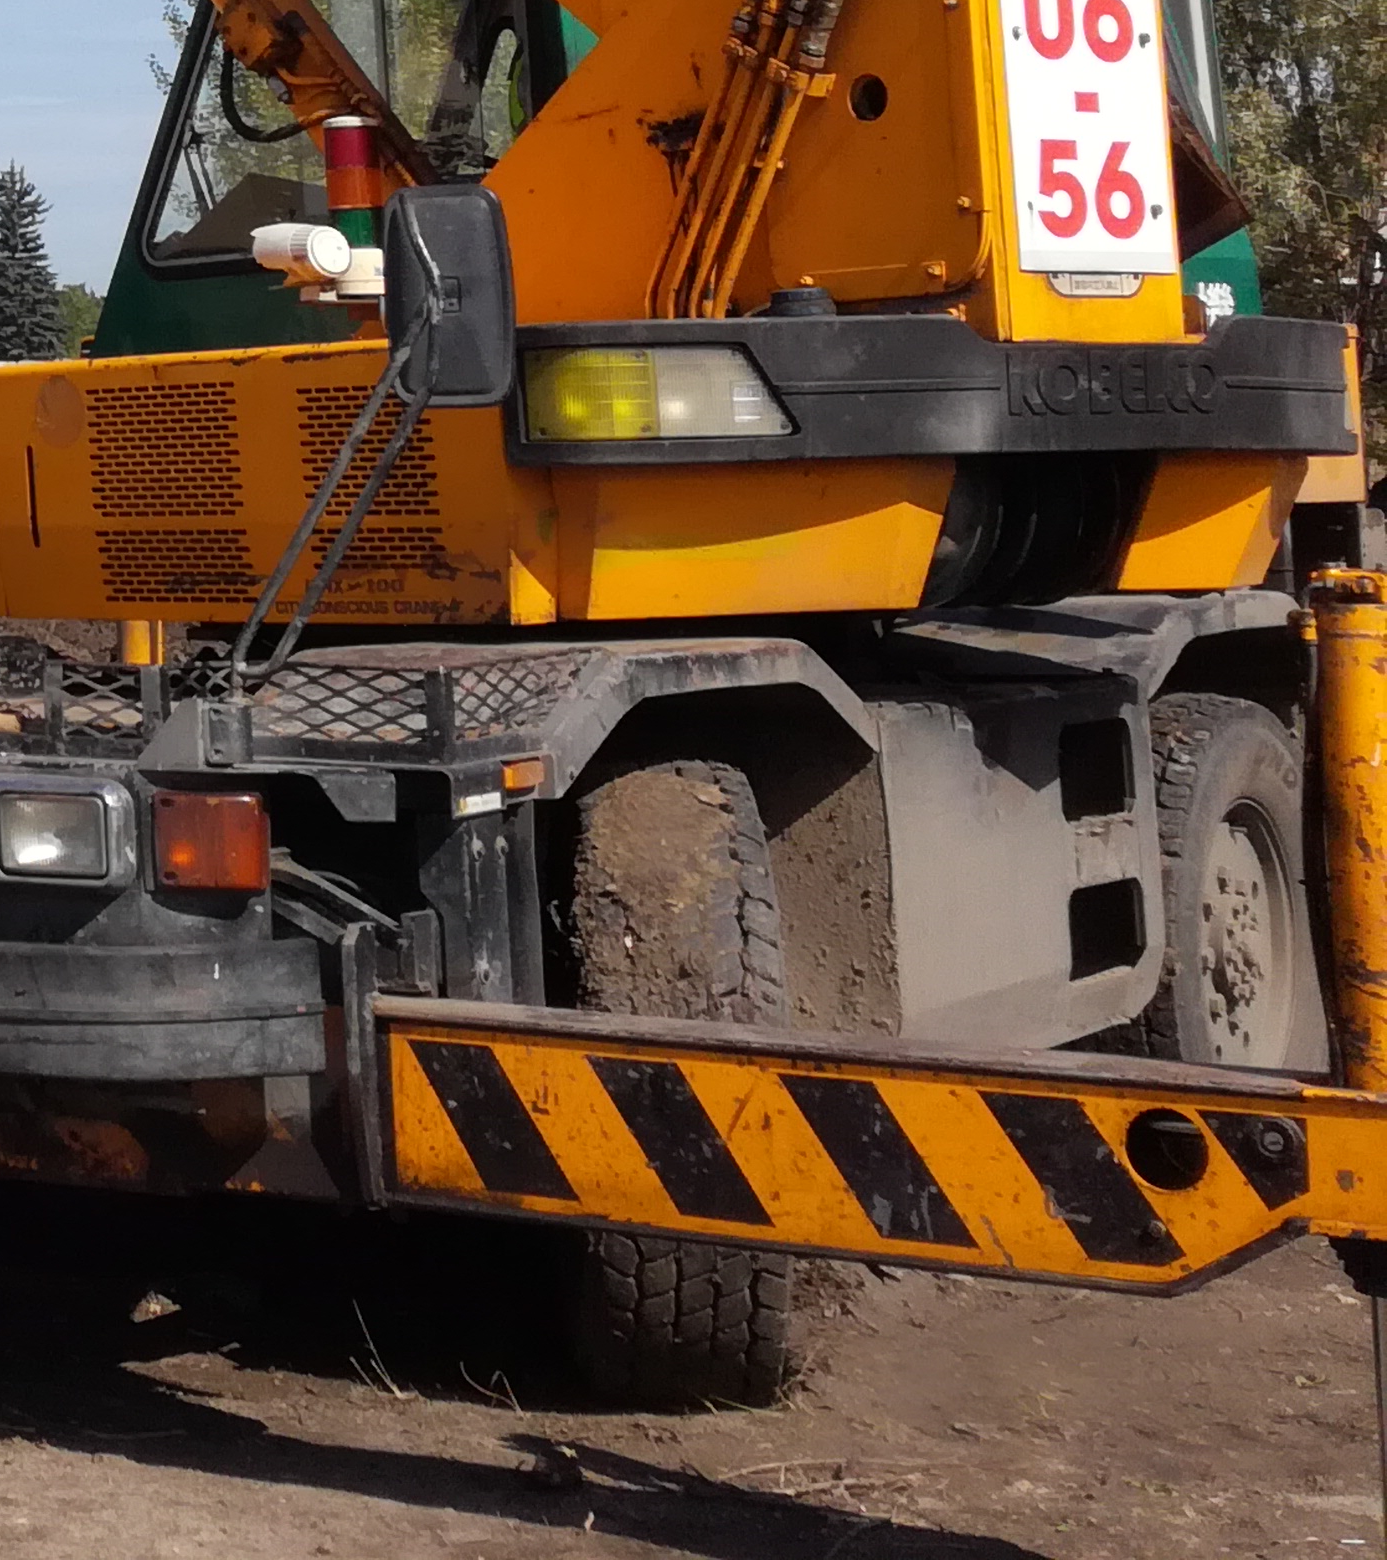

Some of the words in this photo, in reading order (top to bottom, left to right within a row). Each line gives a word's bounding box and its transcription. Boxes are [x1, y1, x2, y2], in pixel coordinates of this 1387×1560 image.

[1038, 138, 1146, 240] 56
[1004, 348, 1217, 417] KOBELCO
[275, 600, 306, 615] CIT
